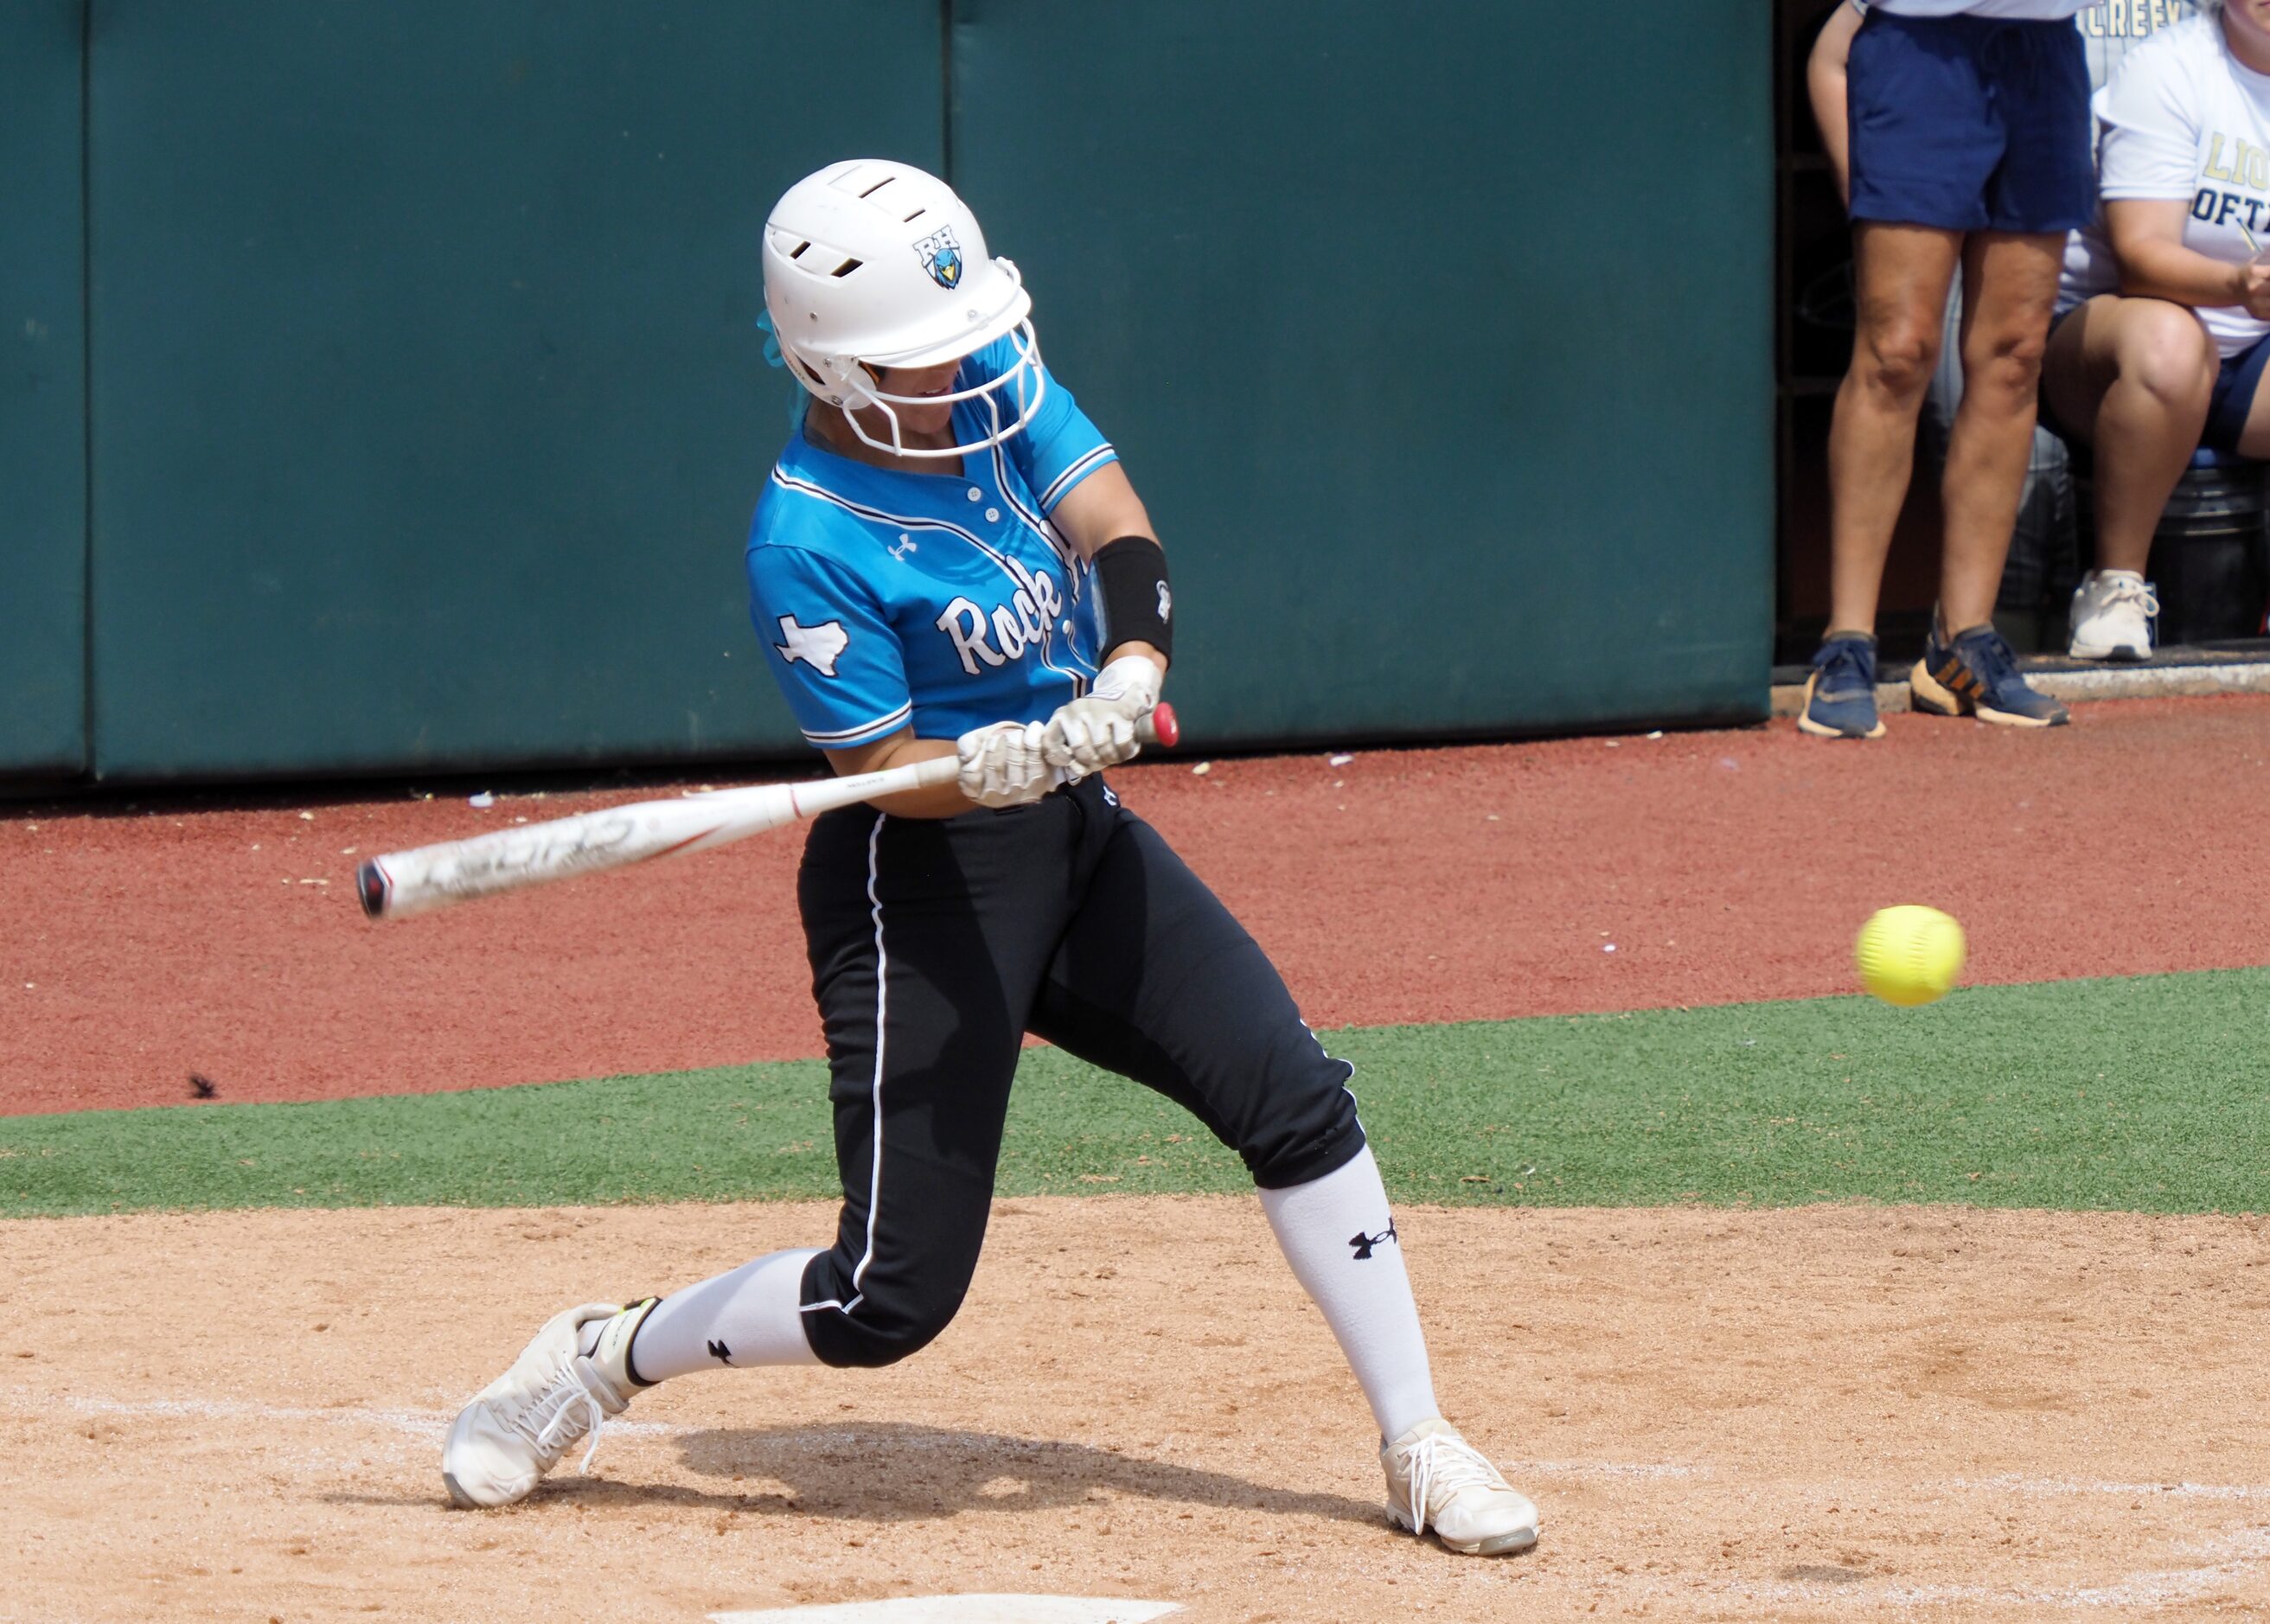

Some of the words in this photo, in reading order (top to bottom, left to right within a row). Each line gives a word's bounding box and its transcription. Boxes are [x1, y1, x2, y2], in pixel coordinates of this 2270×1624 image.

[2192, 187, 2270, 233] OFT
[912, 224, 960, 269] RH
[935, 553, 1063, 675] Rock
